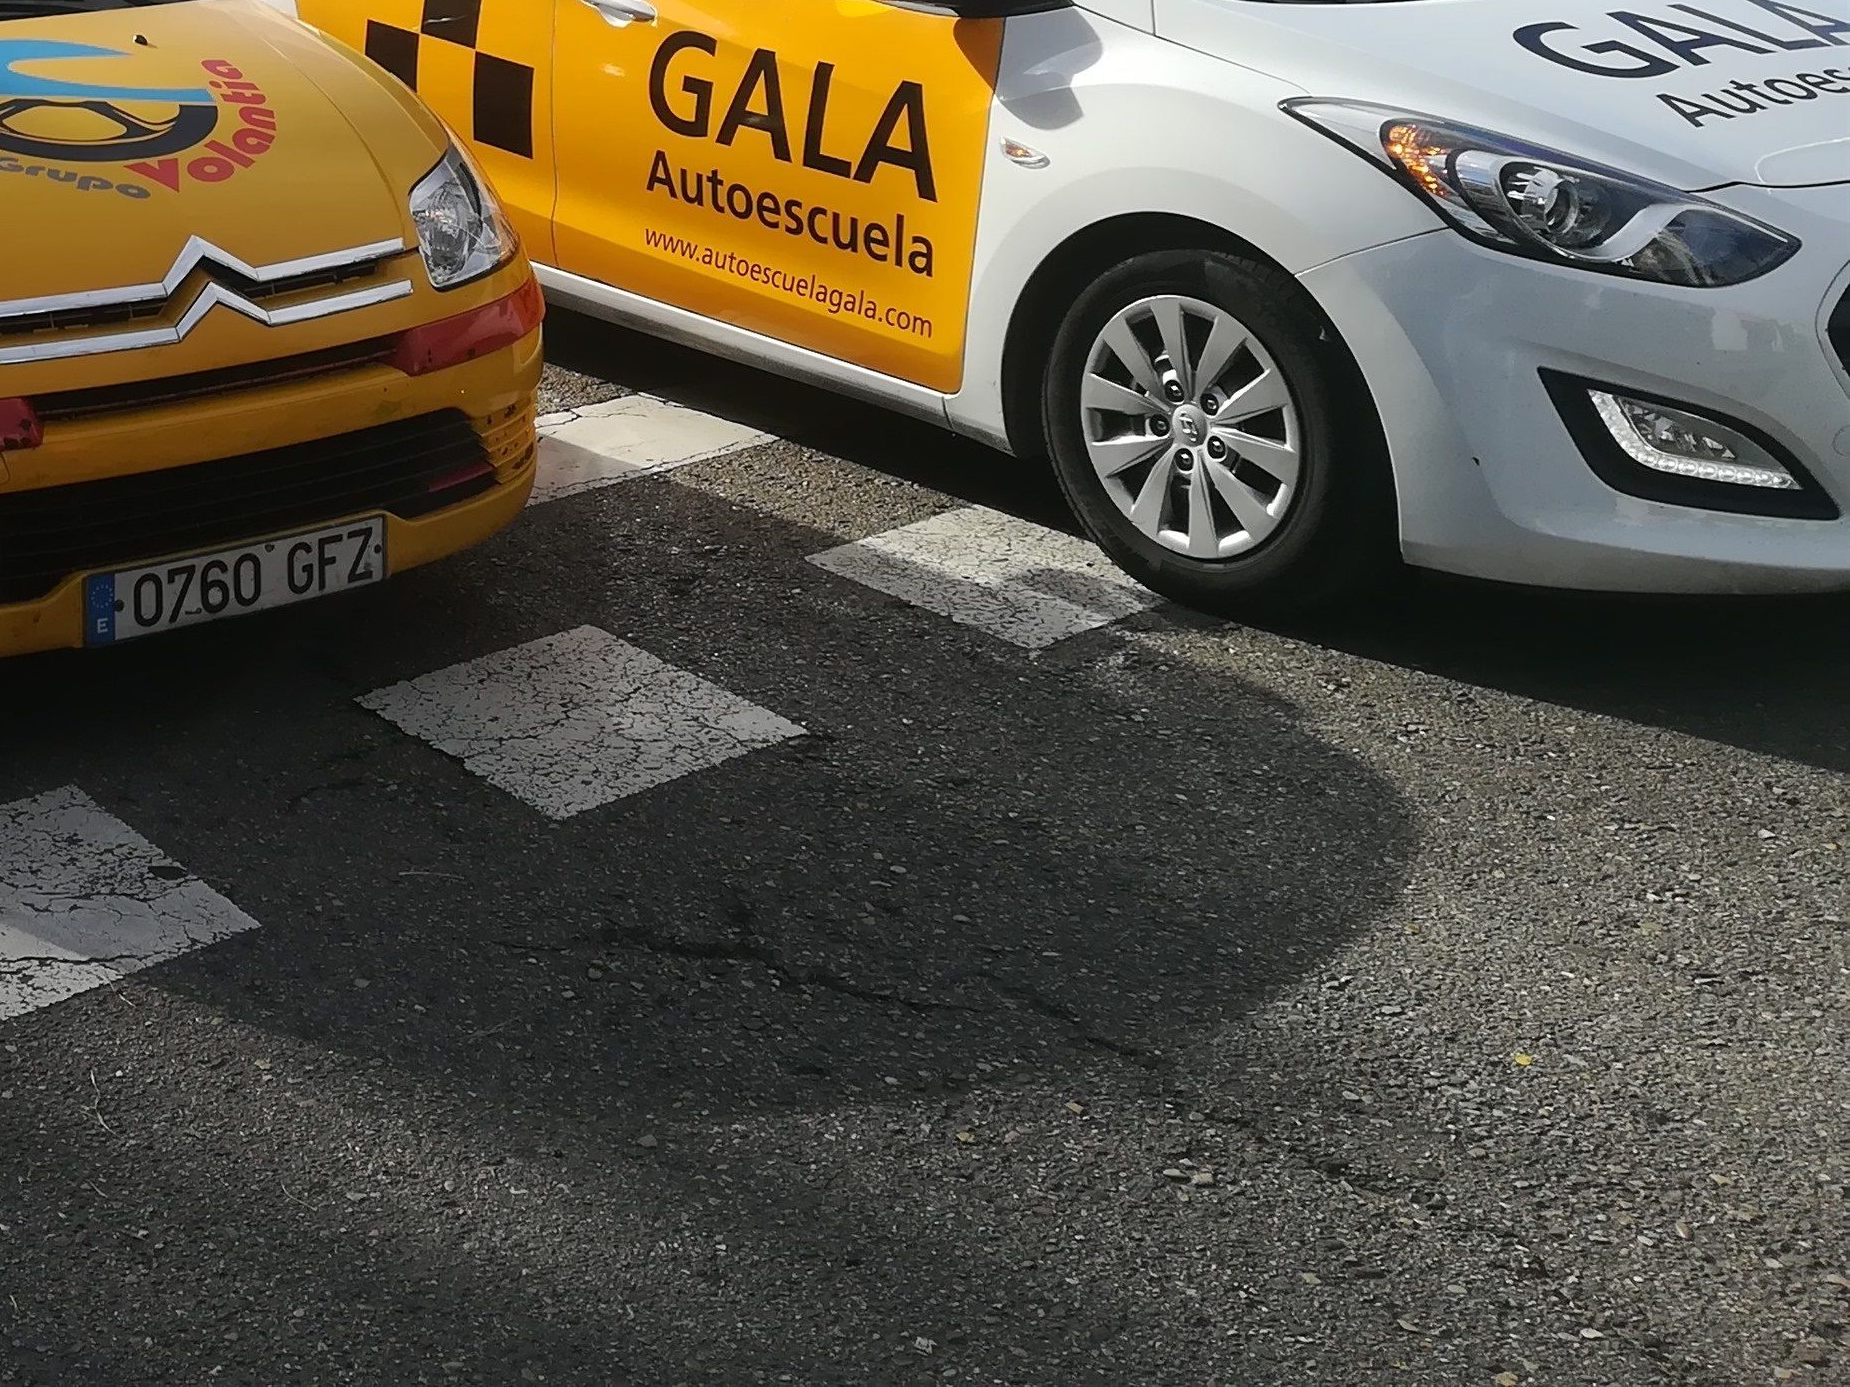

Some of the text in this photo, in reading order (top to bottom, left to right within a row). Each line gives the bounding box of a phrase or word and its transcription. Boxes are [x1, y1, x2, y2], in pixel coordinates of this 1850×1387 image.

[123, 58, 278, 194] Volantia
[648, 30, 938, 203] GALA
[646, 149, 935, 278] Autoescuela
[645, 228, 933, 339] www.autoescuelagala.com
[97, 618, 109, 634] E
[132, 526, 374, 628] 0760 GFZ
